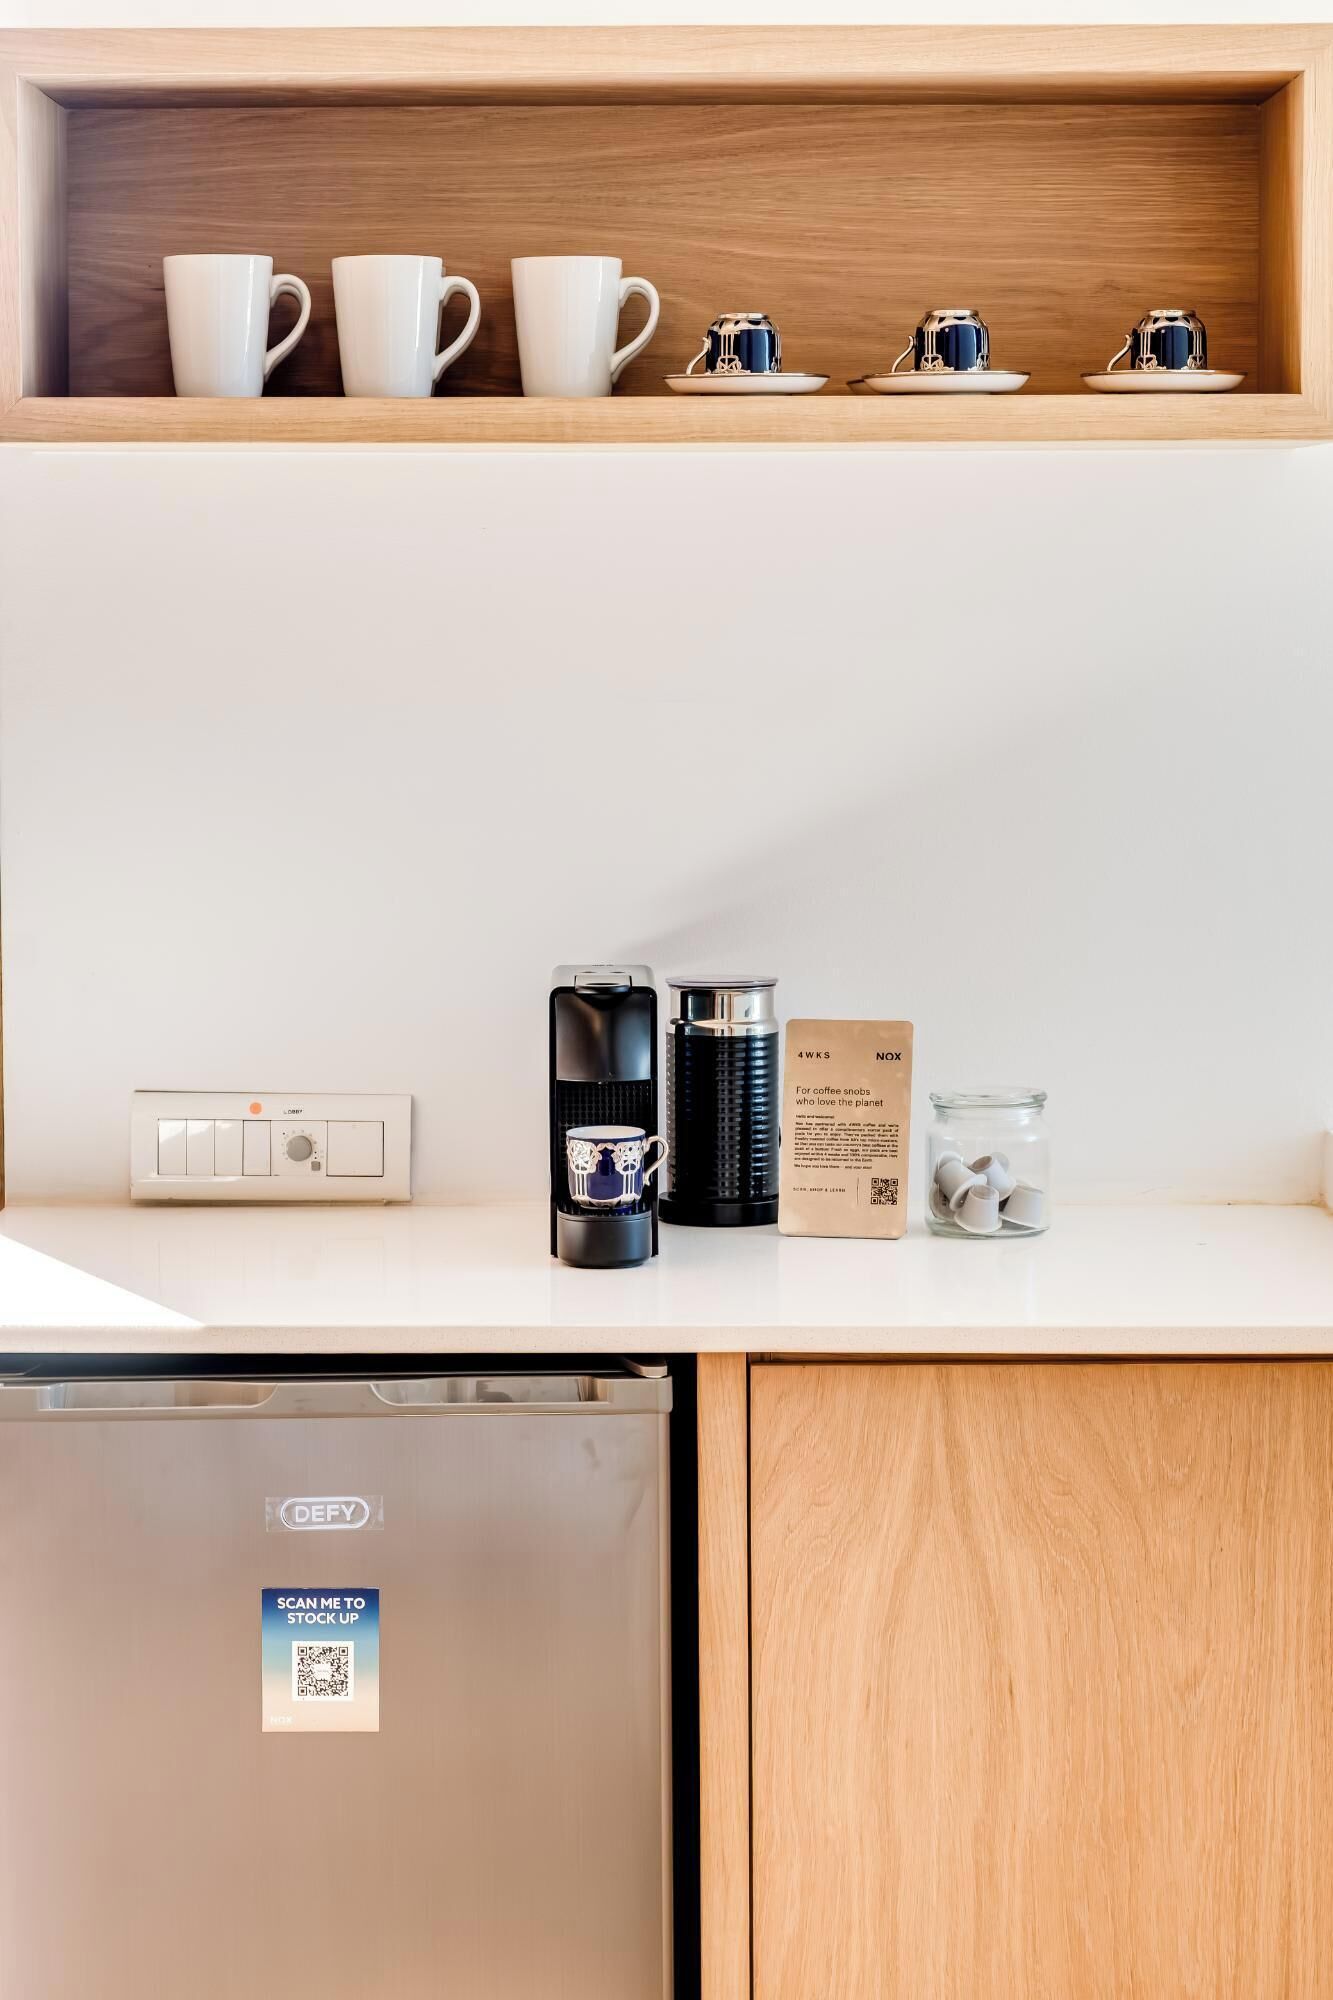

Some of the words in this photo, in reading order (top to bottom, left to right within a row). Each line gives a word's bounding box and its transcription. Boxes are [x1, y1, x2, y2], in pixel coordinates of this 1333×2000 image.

[876, 1052, 902, 1061] NOX
[796, 1086, 810, 1095] For
[813, 1086, 841, 1095] coffee
[843, 1087, 871, 1096] snobs
[795, 1097, 815, 1105] who
[817, 1097, 836, 1106] love
[838, 1098, 853, 1106] the
[855, 1098, 884, 1108] planet
[296, 1504, 356, 1522] DEFY
[277, 1597, 317, 1609] SCAN
[320, 1597, 341, 1609] ME
[343, 1597, 366, 1609] TO
[287, 1612, 336, 1624] STOCK
[339, 1612, 359, 1624] UP
[270, 1715, 293, 1725] NOX
